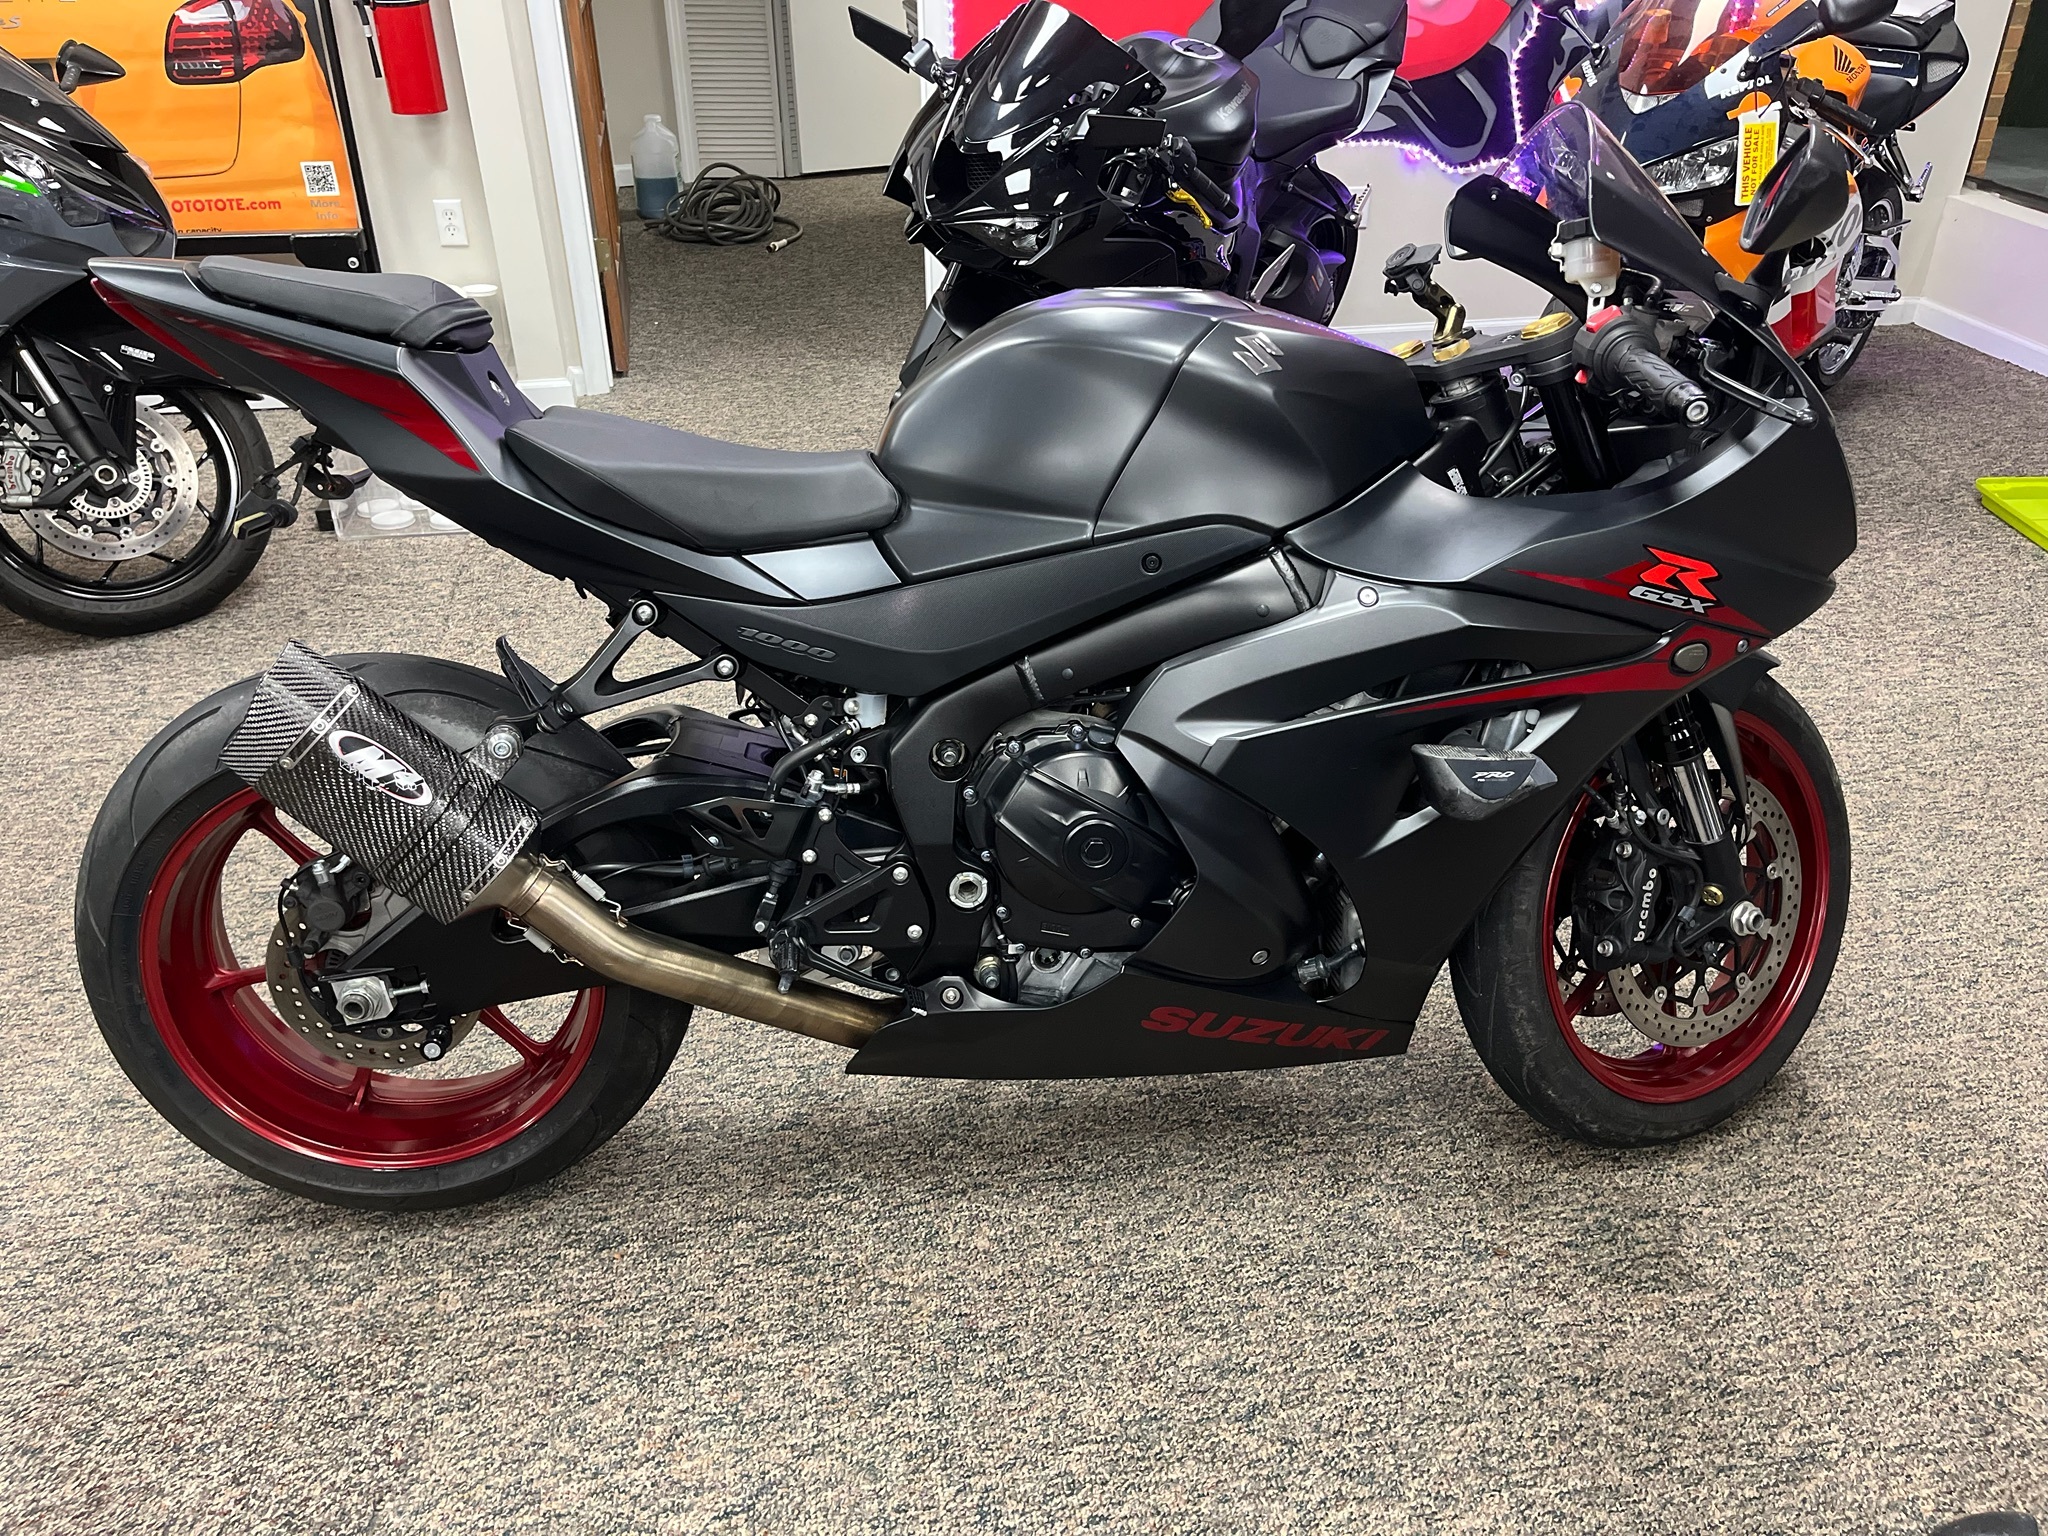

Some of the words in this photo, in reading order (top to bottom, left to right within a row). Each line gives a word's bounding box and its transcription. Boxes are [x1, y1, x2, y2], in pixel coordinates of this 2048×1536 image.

[1846, 63, 1867, 84] HONDA
[1216, 80, 1252, 120] Kawasaki
[1743, 127, 1753, 173] VEHICLE
[310, 200, 340, 208] More
[1741, 175, 1750, 199] THIS
[316, 211, 339, 220] Info
[5, 455, 16, 490] brembo
[1639, 546, 1719, 601] R
[1628, 585, 1715, 614] GSX
[737, 626, 838, 663] 1000
[1471, 770, 1516, 779] PRO
[1633, 867, 1657, 942] brembo
[1140, 1005, 1391, 1051] SUZUKI
